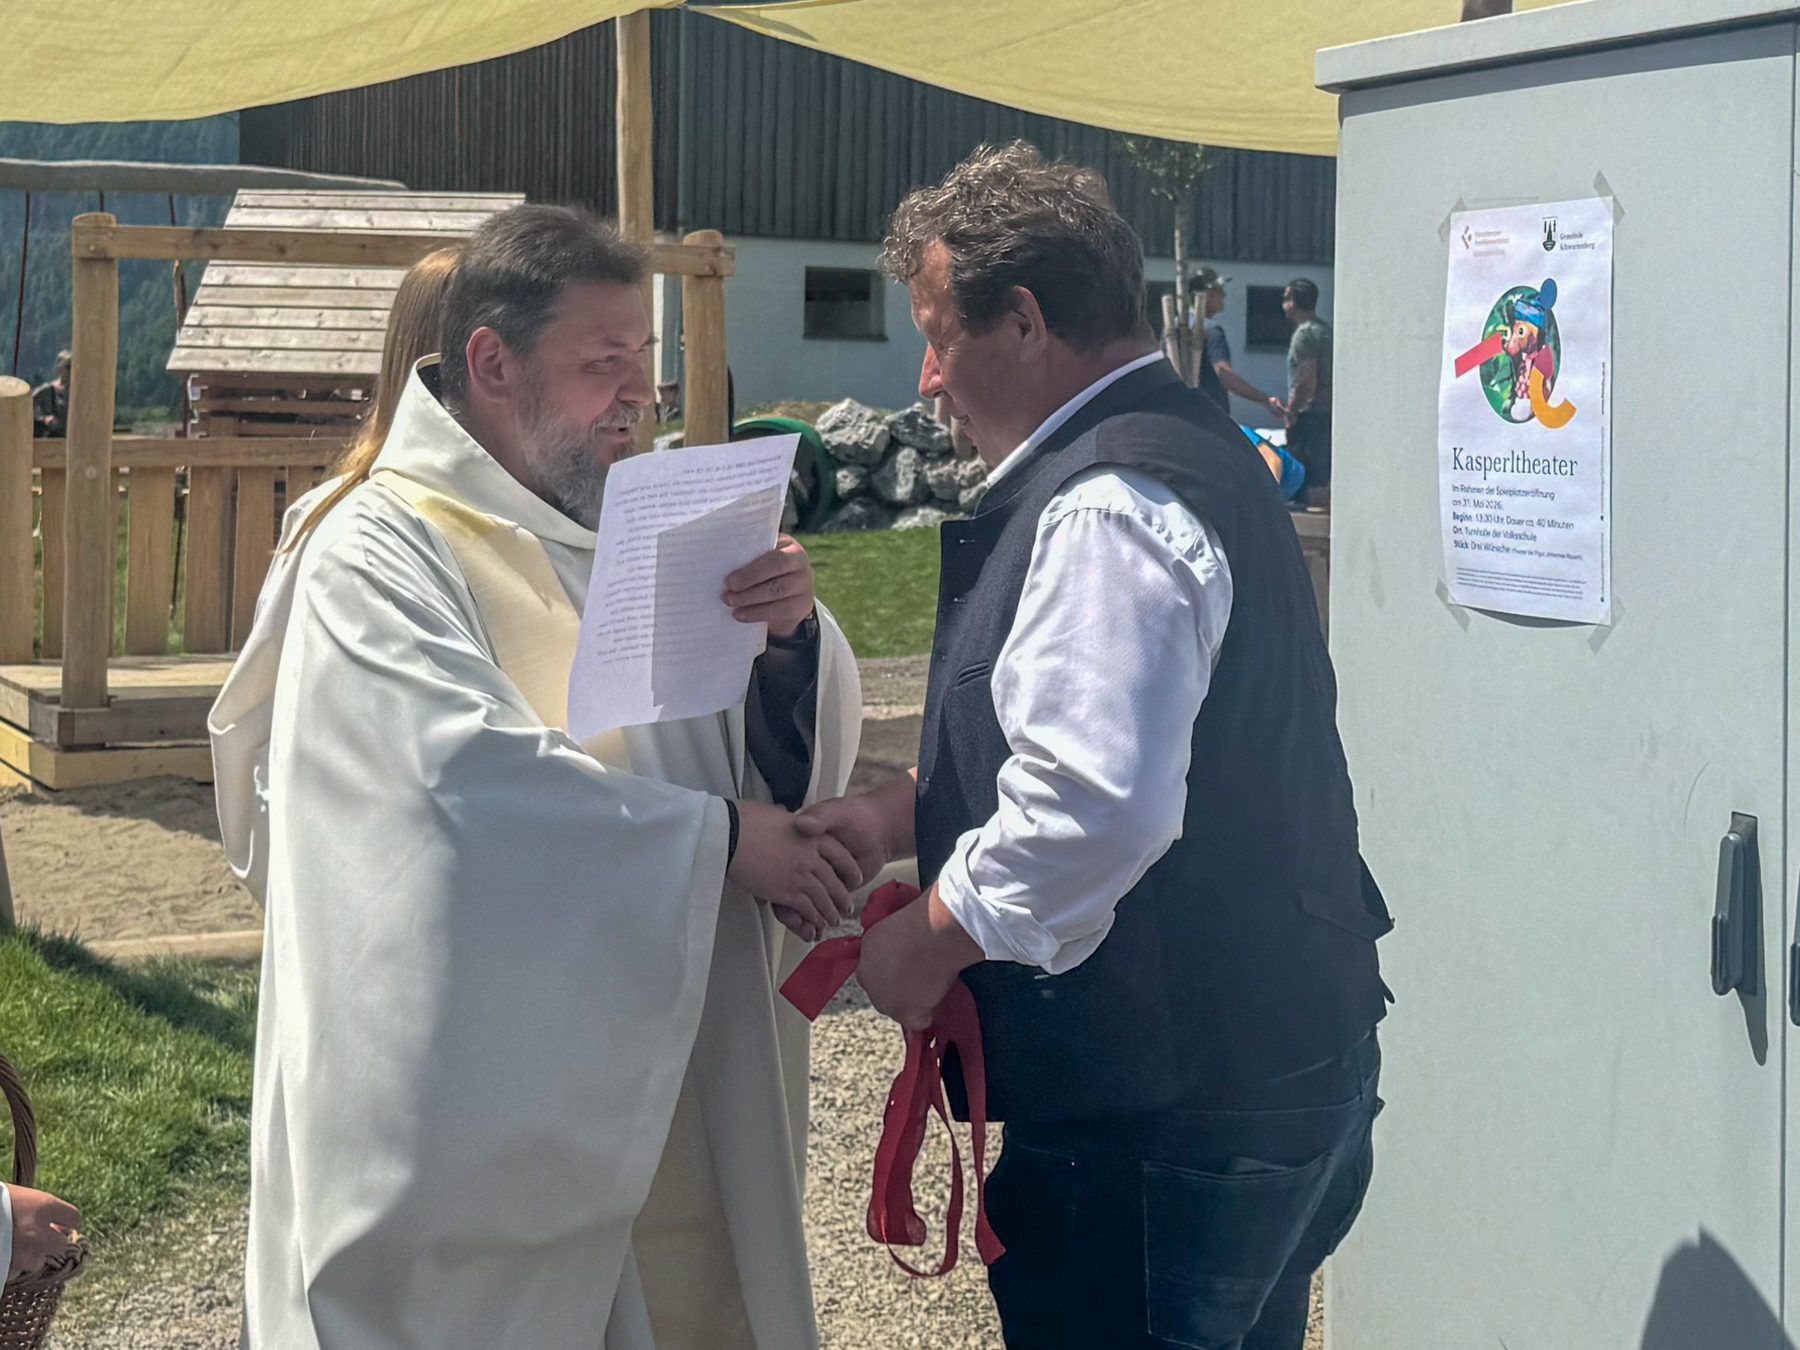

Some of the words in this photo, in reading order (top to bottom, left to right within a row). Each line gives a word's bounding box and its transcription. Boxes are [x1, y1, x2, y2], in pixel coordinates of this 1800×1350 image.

[1452, 447, 1578, 480] Kasperltheater
[1452, 484, 1460, 492] Im
[1460, 484, 1484, 494] Rahmen
[1485, 486, 1495, 495] der
[1496, 485, 1555, 501] Spielplatzeröffnung
[1452, 499, 1461, 507] am
[1473, 499, 1484, 509] Mai
[1505, 516, 1525, 526] Dauer
[1536, 518, 1546, 528] 40
[1547, 519, 1575, 531] Minuten
[1491, 529, 1502, 539] der
[1470, 541, 1483, 551] Drei
[1483, 543, 1510, 553] Wünsche
